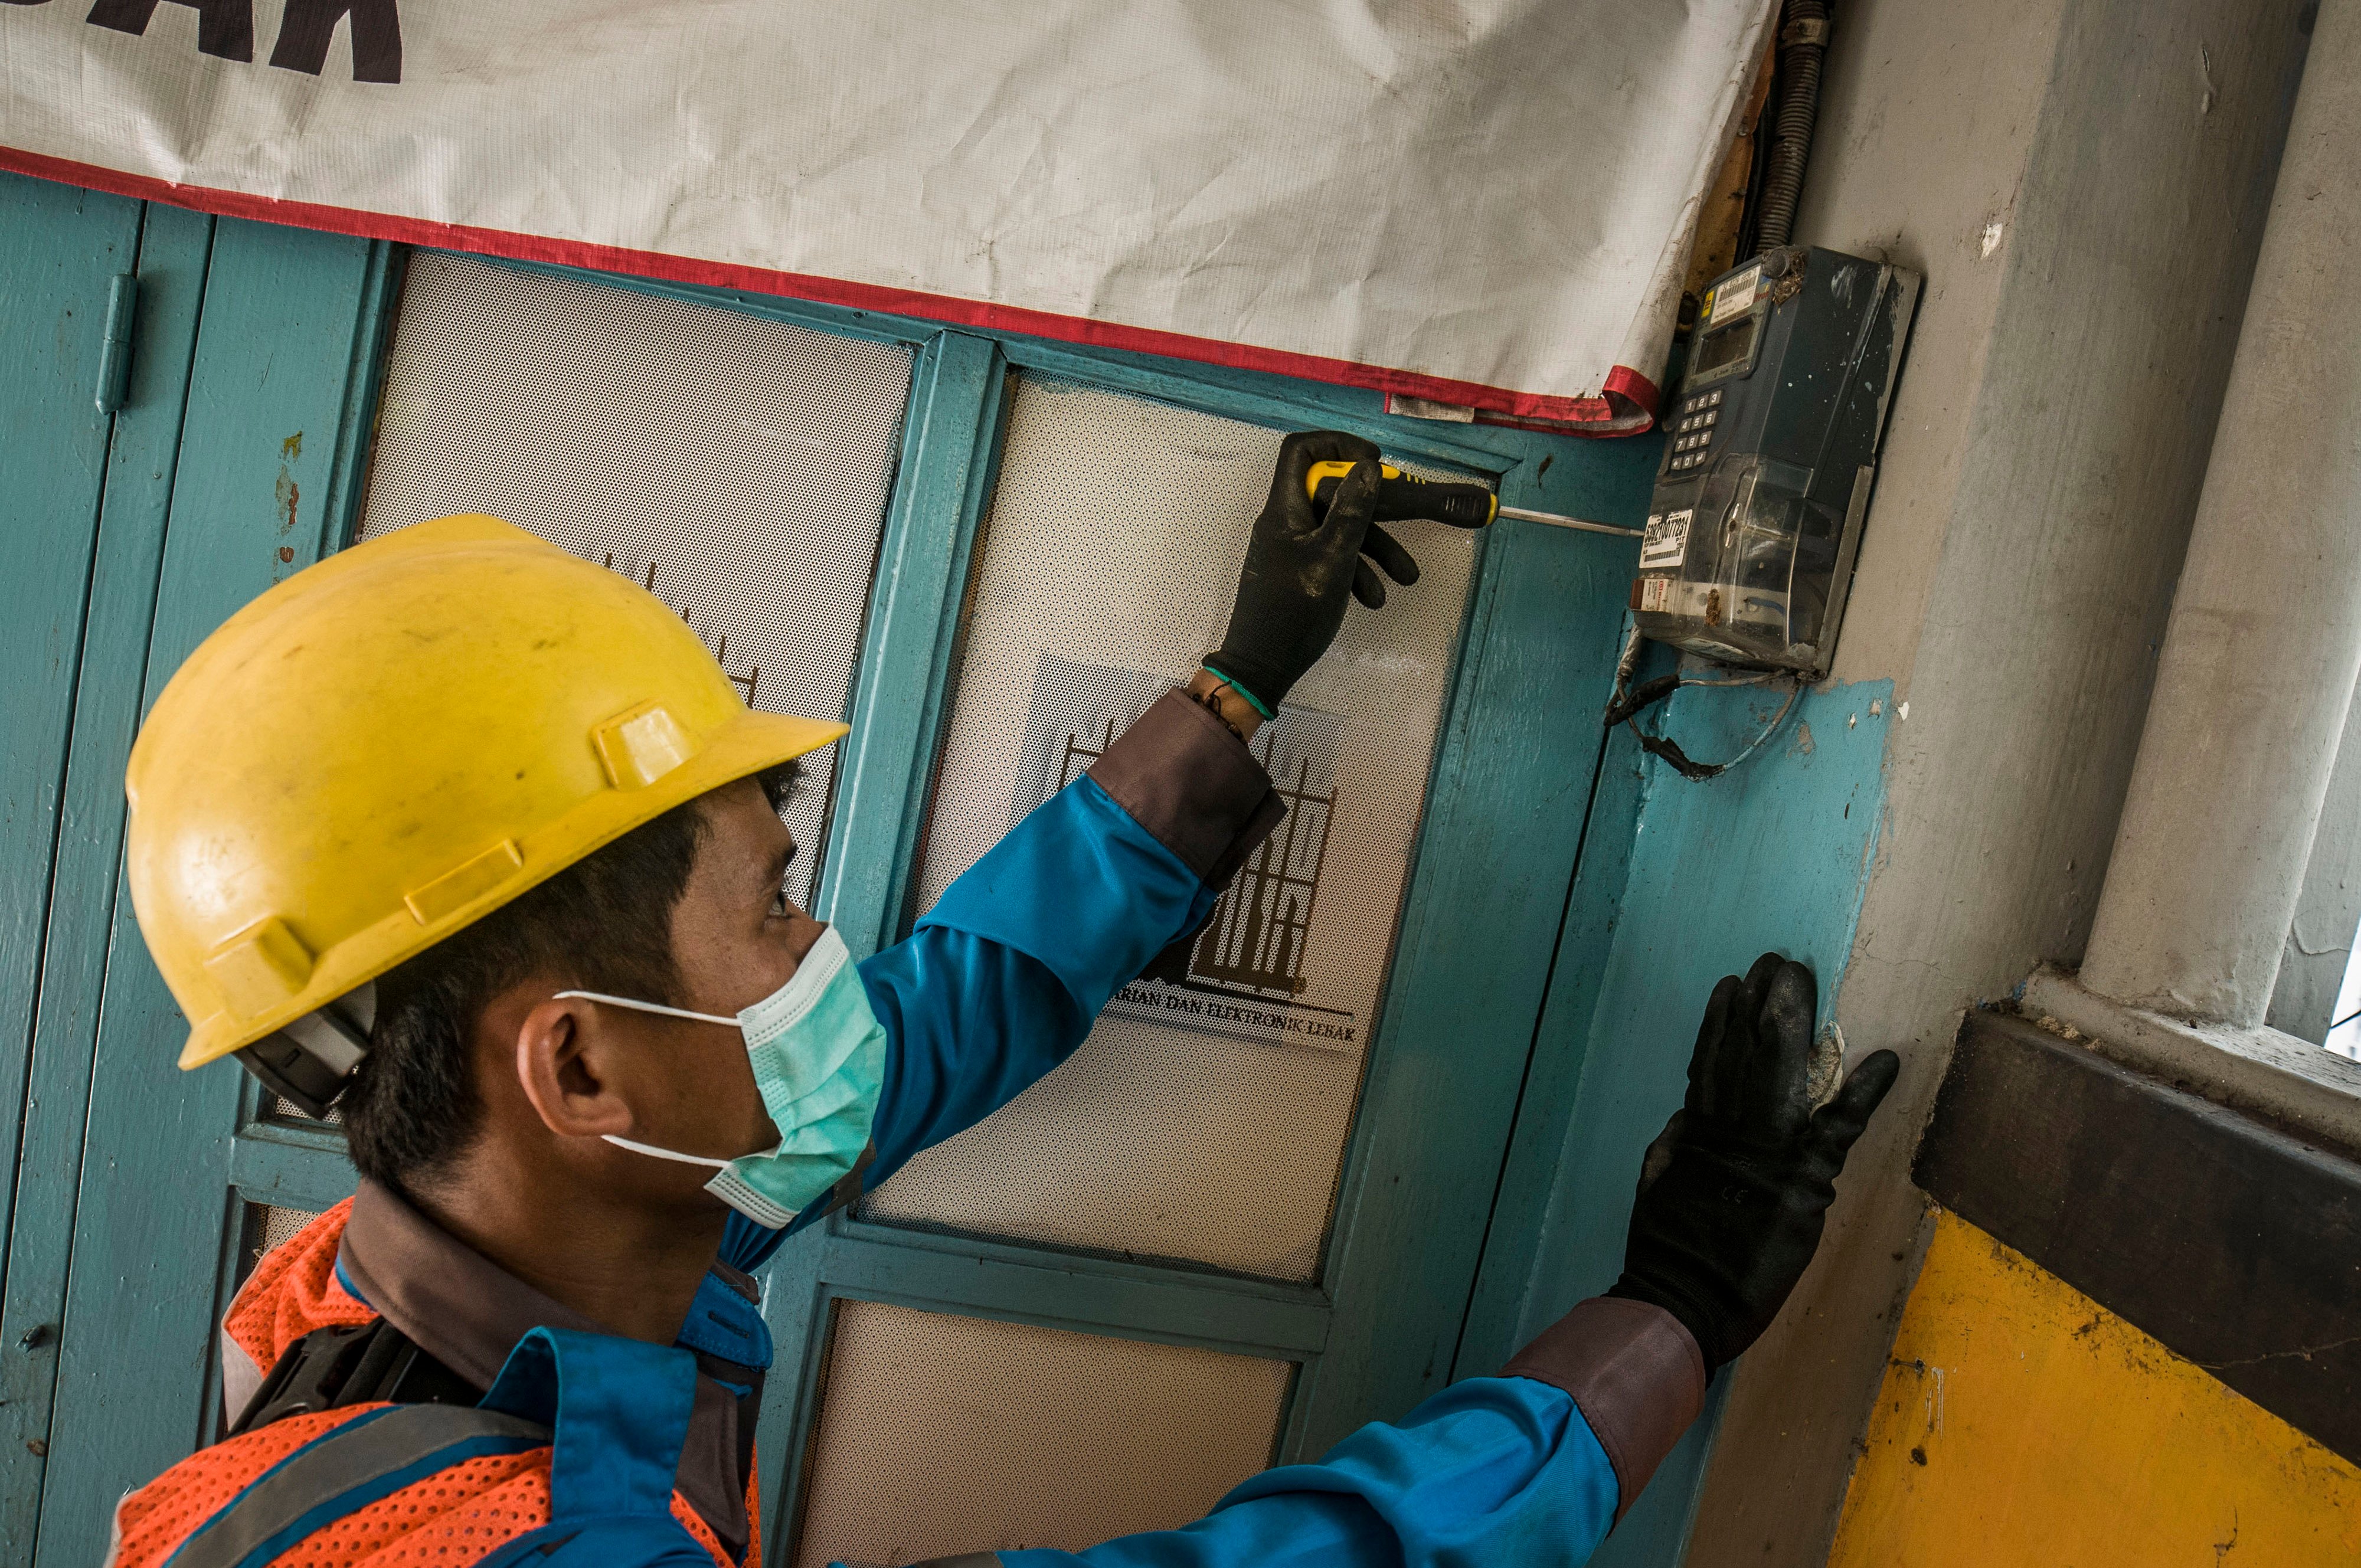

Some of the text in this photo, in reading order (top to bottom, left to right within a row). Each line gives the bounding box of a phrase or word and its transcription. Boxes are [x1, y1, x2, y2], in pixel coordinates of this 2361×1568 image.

[1688, 394, 1718, 411] 1 2 3
[1682, 414, 1712, 430] 4 5 6
[1677, 434, 1708, 449] 7 8 9
[1684, 457, 1690, 466] 0
[1165, 995, 1202, 1014] DAN
